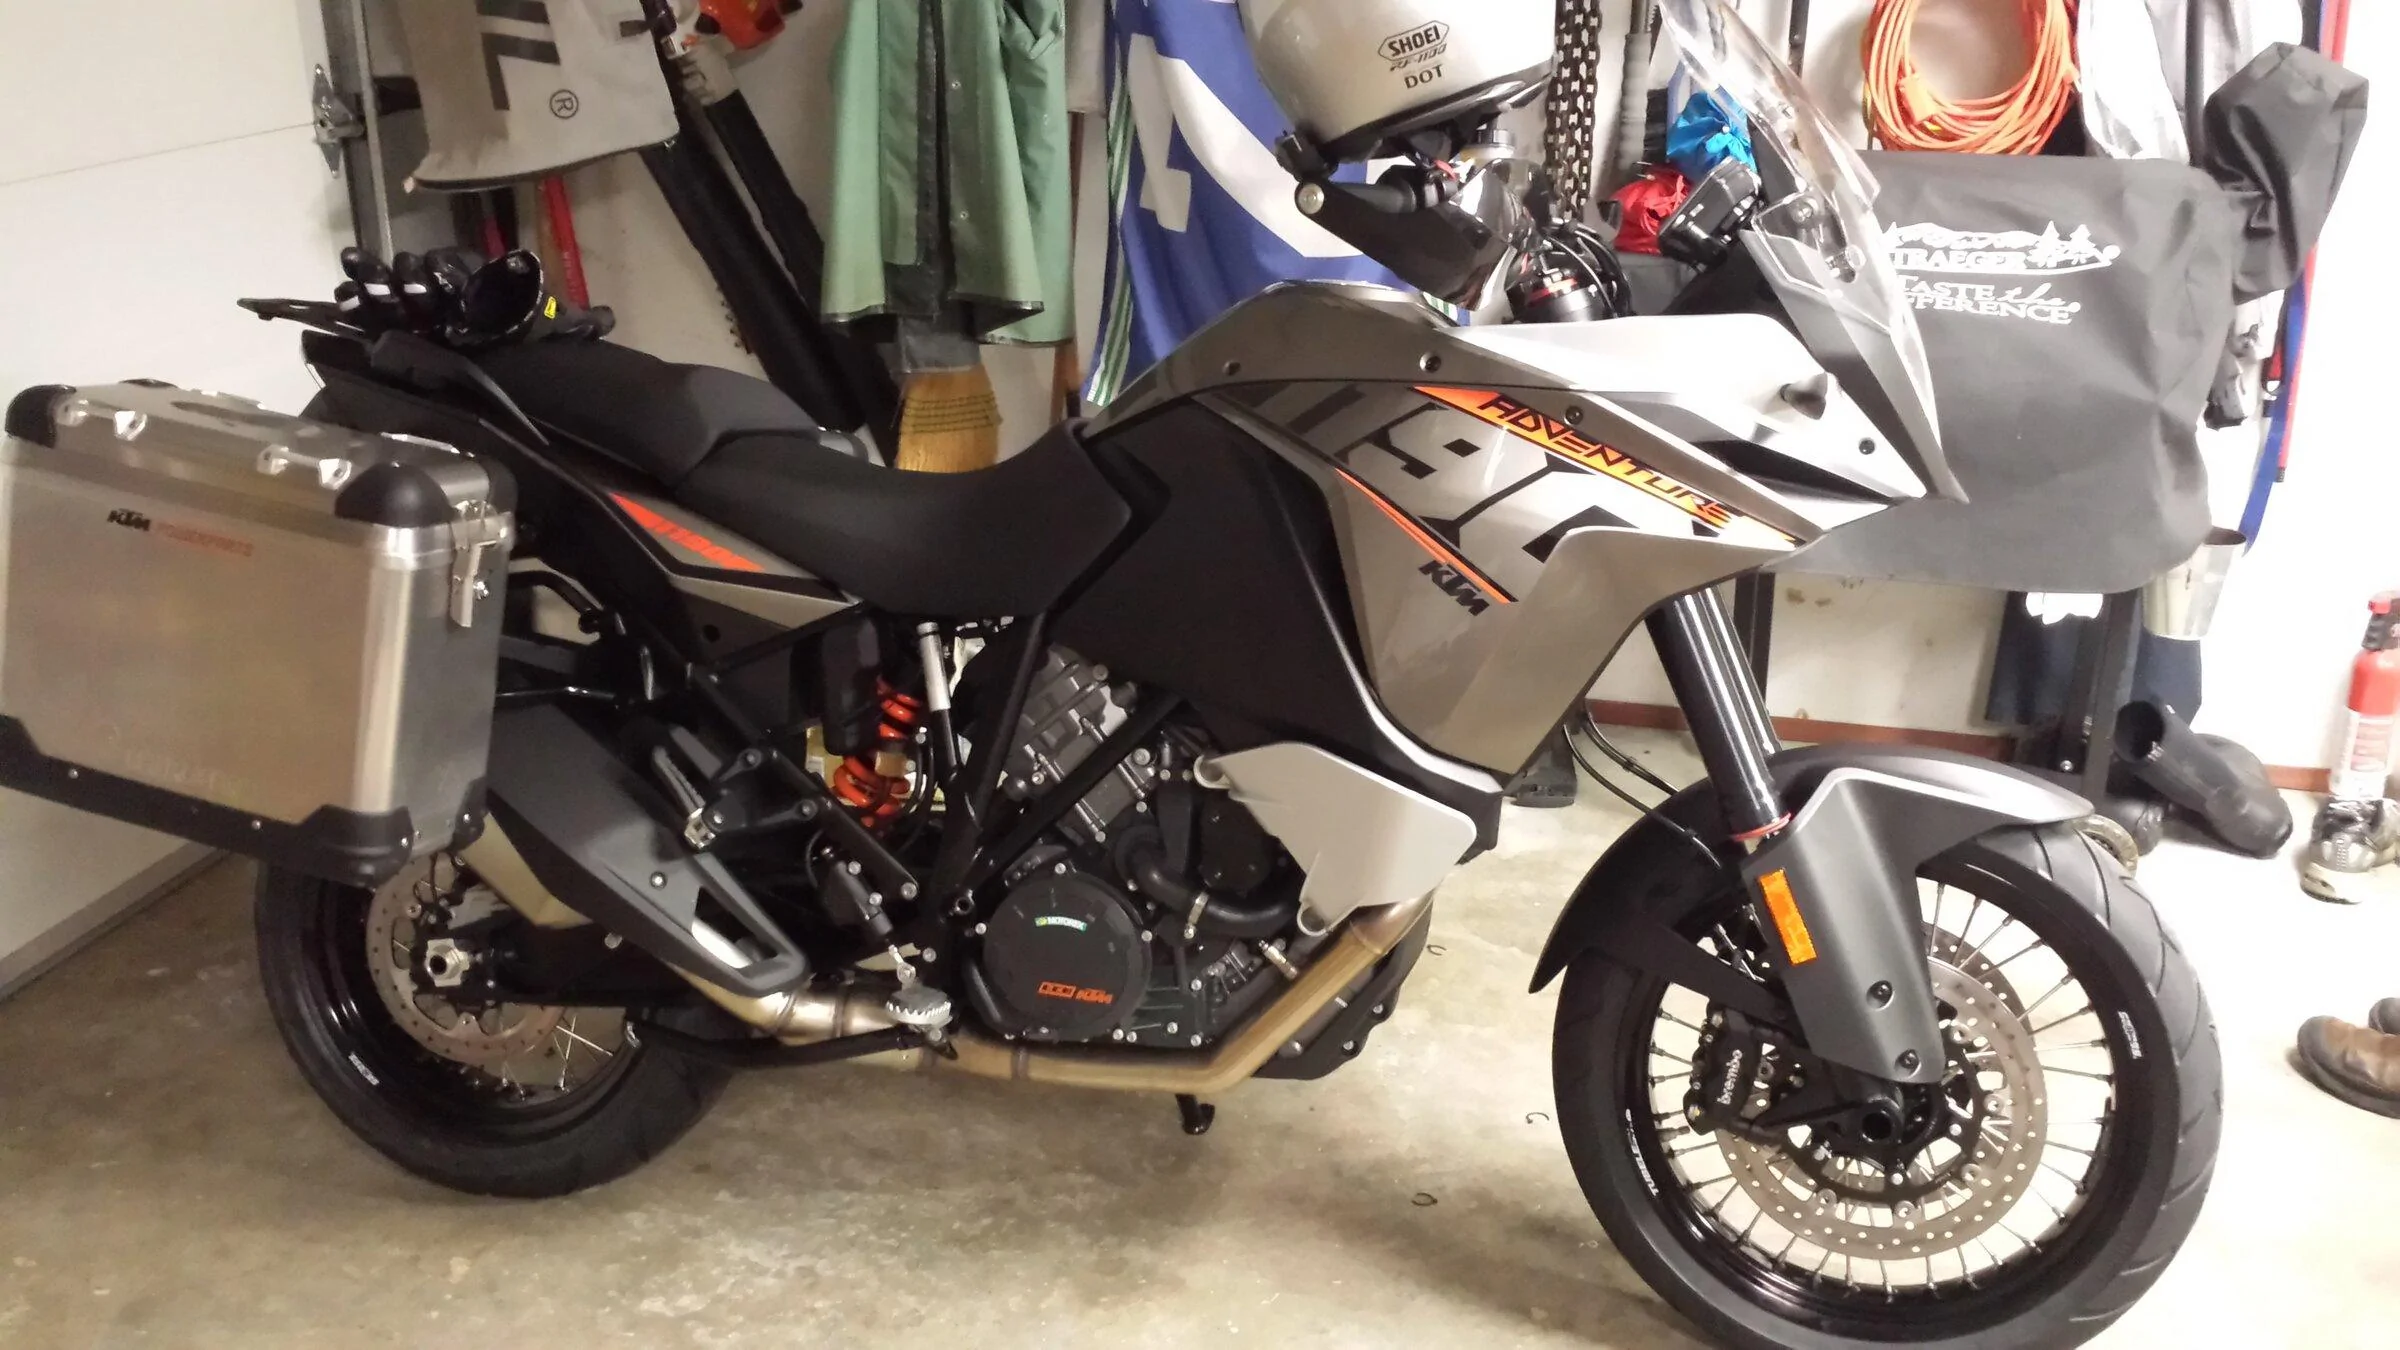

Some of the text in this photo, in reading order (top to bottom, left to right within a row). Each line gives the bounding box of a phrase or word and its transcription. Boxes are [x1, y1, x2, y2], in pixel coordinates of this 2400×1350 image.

[1387, 24, 1441, 57] SHOEI
[1404, 64, 1443, 89] DOT
[1995, 283, 2067, 306] the
[1478, 392, 1732, 530] ADVENTURE
[107, 507, 151, 532] KTM
[1418, 560, 1490, 616] KTM
[1716, 1049, 1743, 1105] brembo
